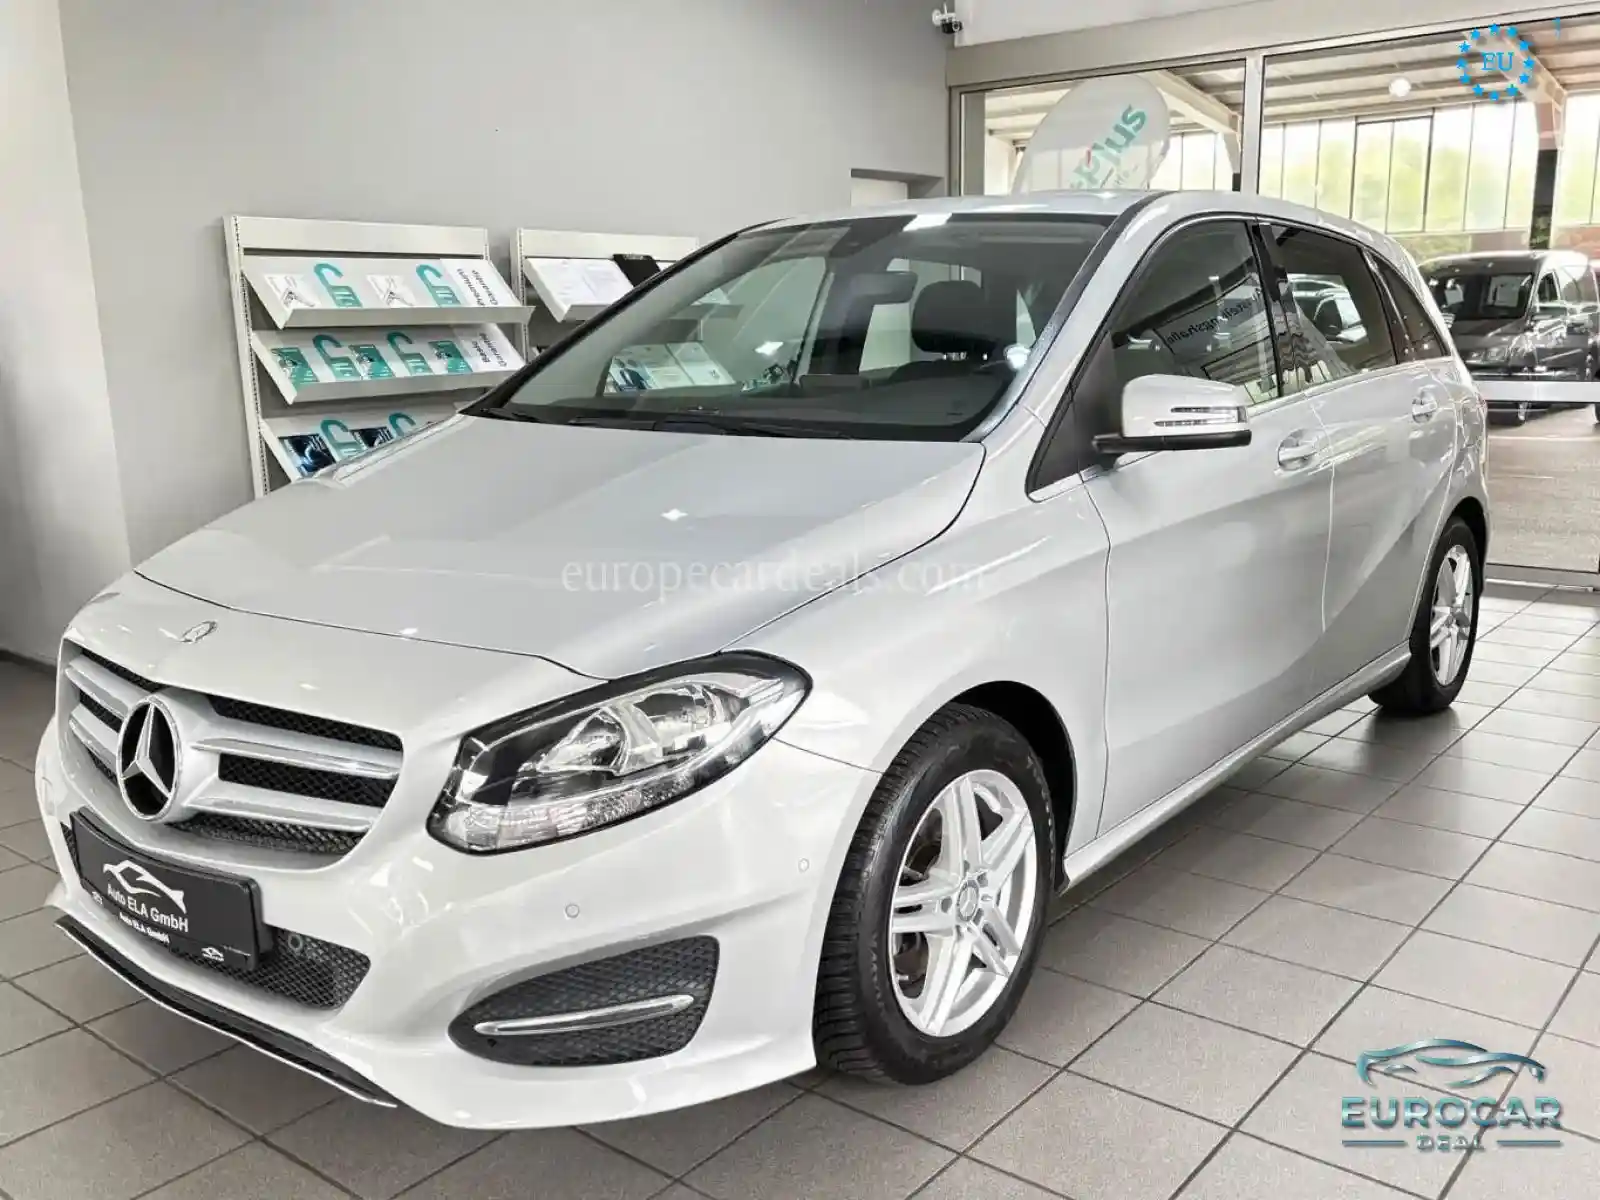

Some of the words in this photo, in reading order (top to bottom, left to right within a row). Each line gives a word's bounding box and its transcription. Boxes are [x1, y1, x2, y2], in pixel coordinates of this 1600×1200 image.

[107, 883, 126, 906] Auto
[127, 895, 149, 919] ELA
[150, 907, 189, 933] GmbH
